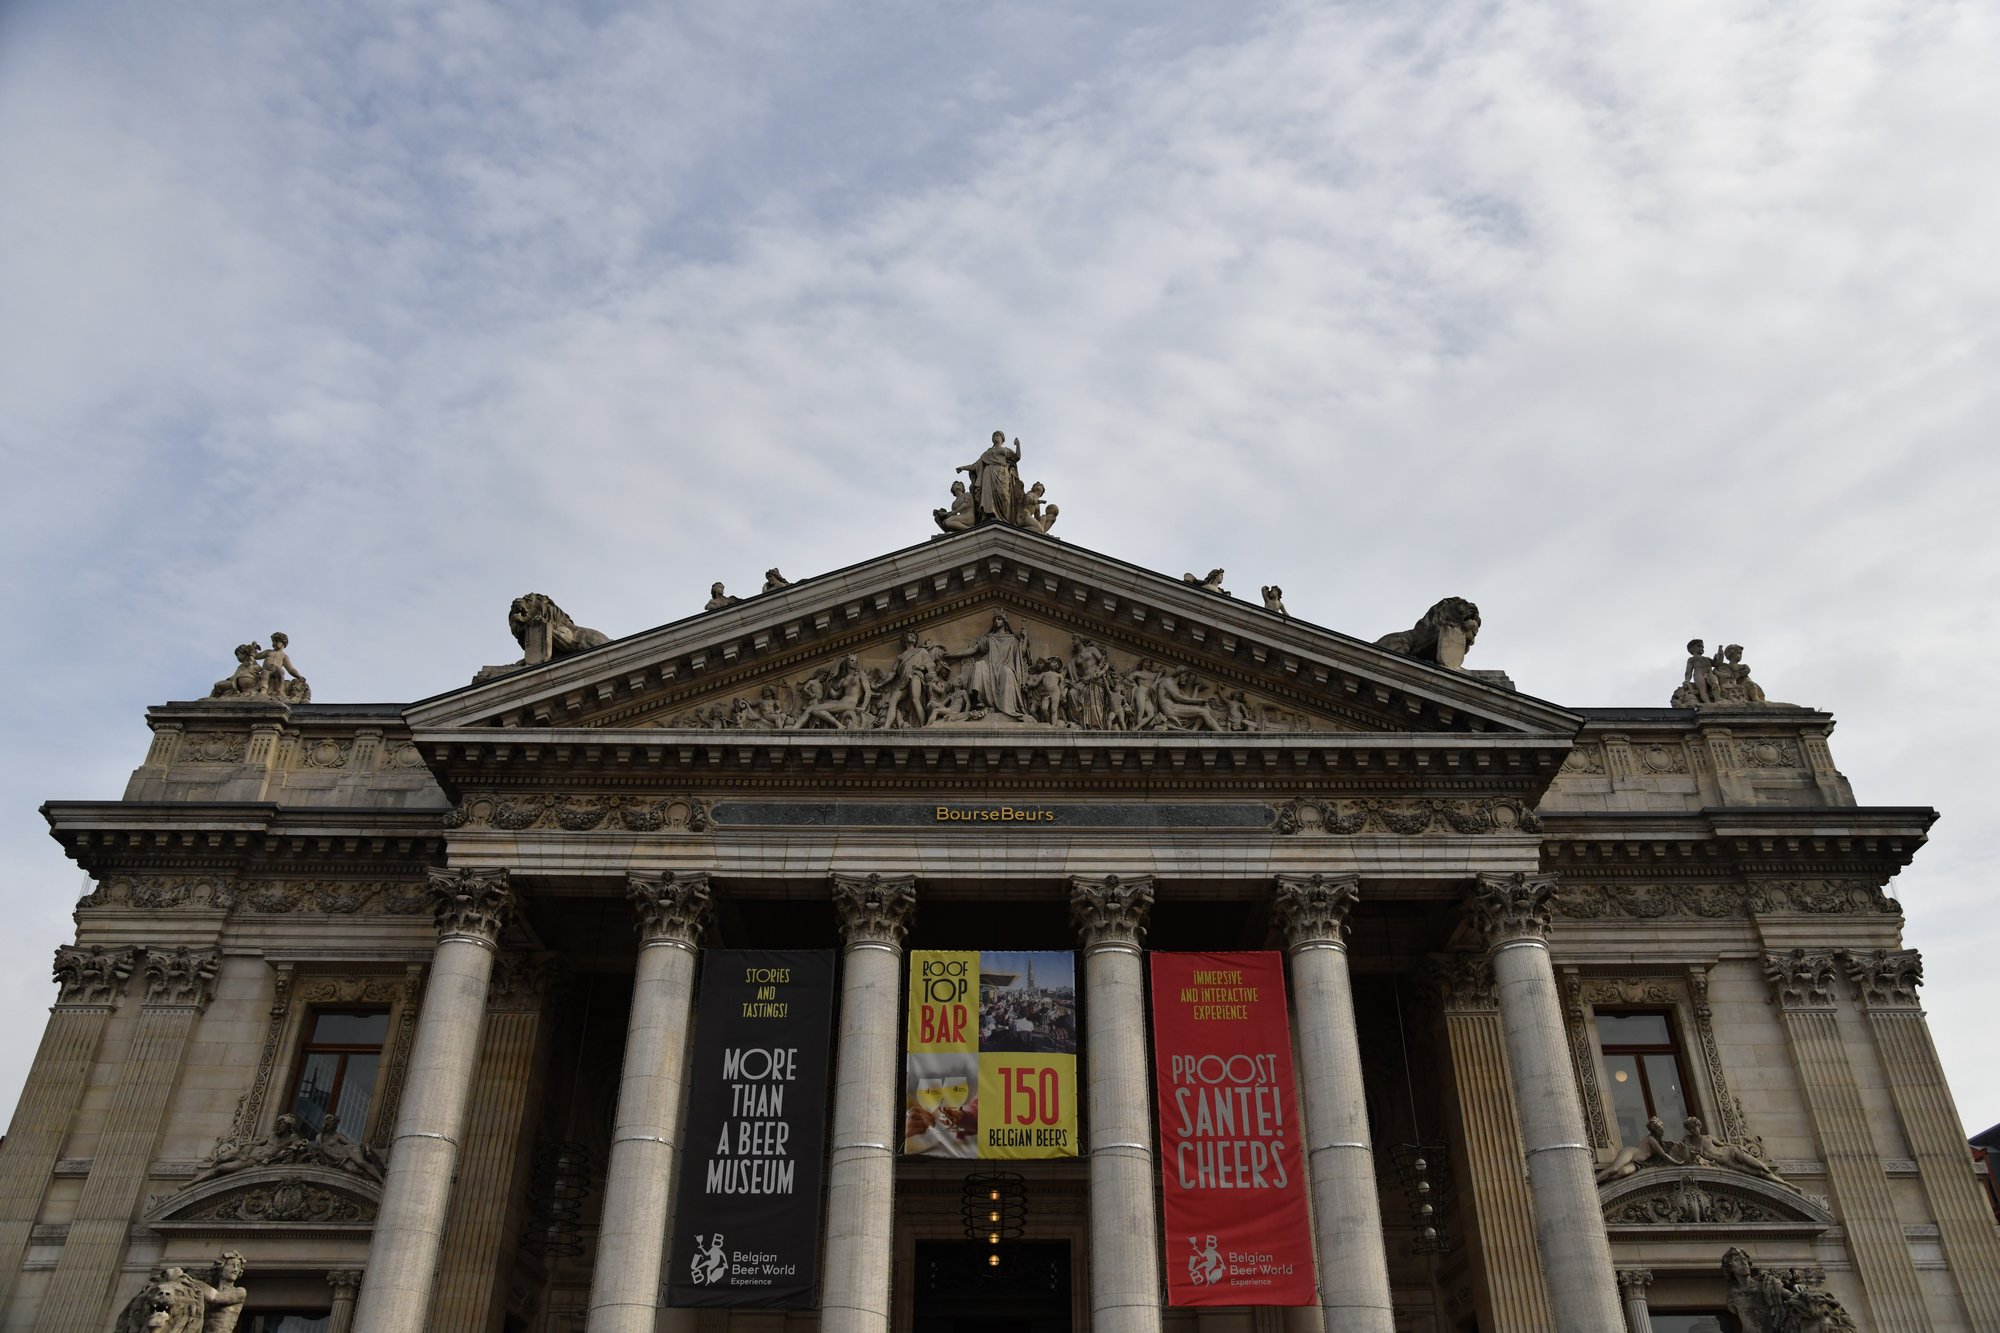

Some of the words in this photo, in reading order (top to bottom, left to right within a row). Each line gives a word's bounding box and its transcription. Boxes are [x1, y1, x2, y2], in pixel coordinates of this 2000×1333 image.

[936, 806, 1054, 821] BourseBeurs
[922, 960, 968, 977] ROOF
[756, 986, 776, 1000] AND
[922, 978, 968, 1003] TOP
[1180, 988, 1199, 1003] AND
[920, 1005, 968, 1044] BAR
[722, 1048, 798, 1080] MORE
[1171, 1053, 1277, 1085] PROOST
[731, 1084, 784, 1117] THAN
[998, 1067, 1060, 1126] 150
[1175, 1082, 1284, 1138] SANTÉ!
[716, 1121, 730, 1155] A
[737, 1121, 790, 1156] BEER
[1036, 1128, 1069, 1147] BEERS
[1177, 1140, 1289, 1190] CHEERS
[705, 1159, 795, 1195] MUSEUM
[733, 1251, 777, 1265] Belgian
[1229, 1252, 1273, 1266] Belgian
[731, 1264, 760, 1275] Beer
[761, 1264, 796, 1276] World
[1230, 1265, 1258, 1276] Beer
[1259, 1264, 1293, 1275] World
[730, 1277, 772, 1287] Experience
[1230, 1278, 1272, 1287] Experience
